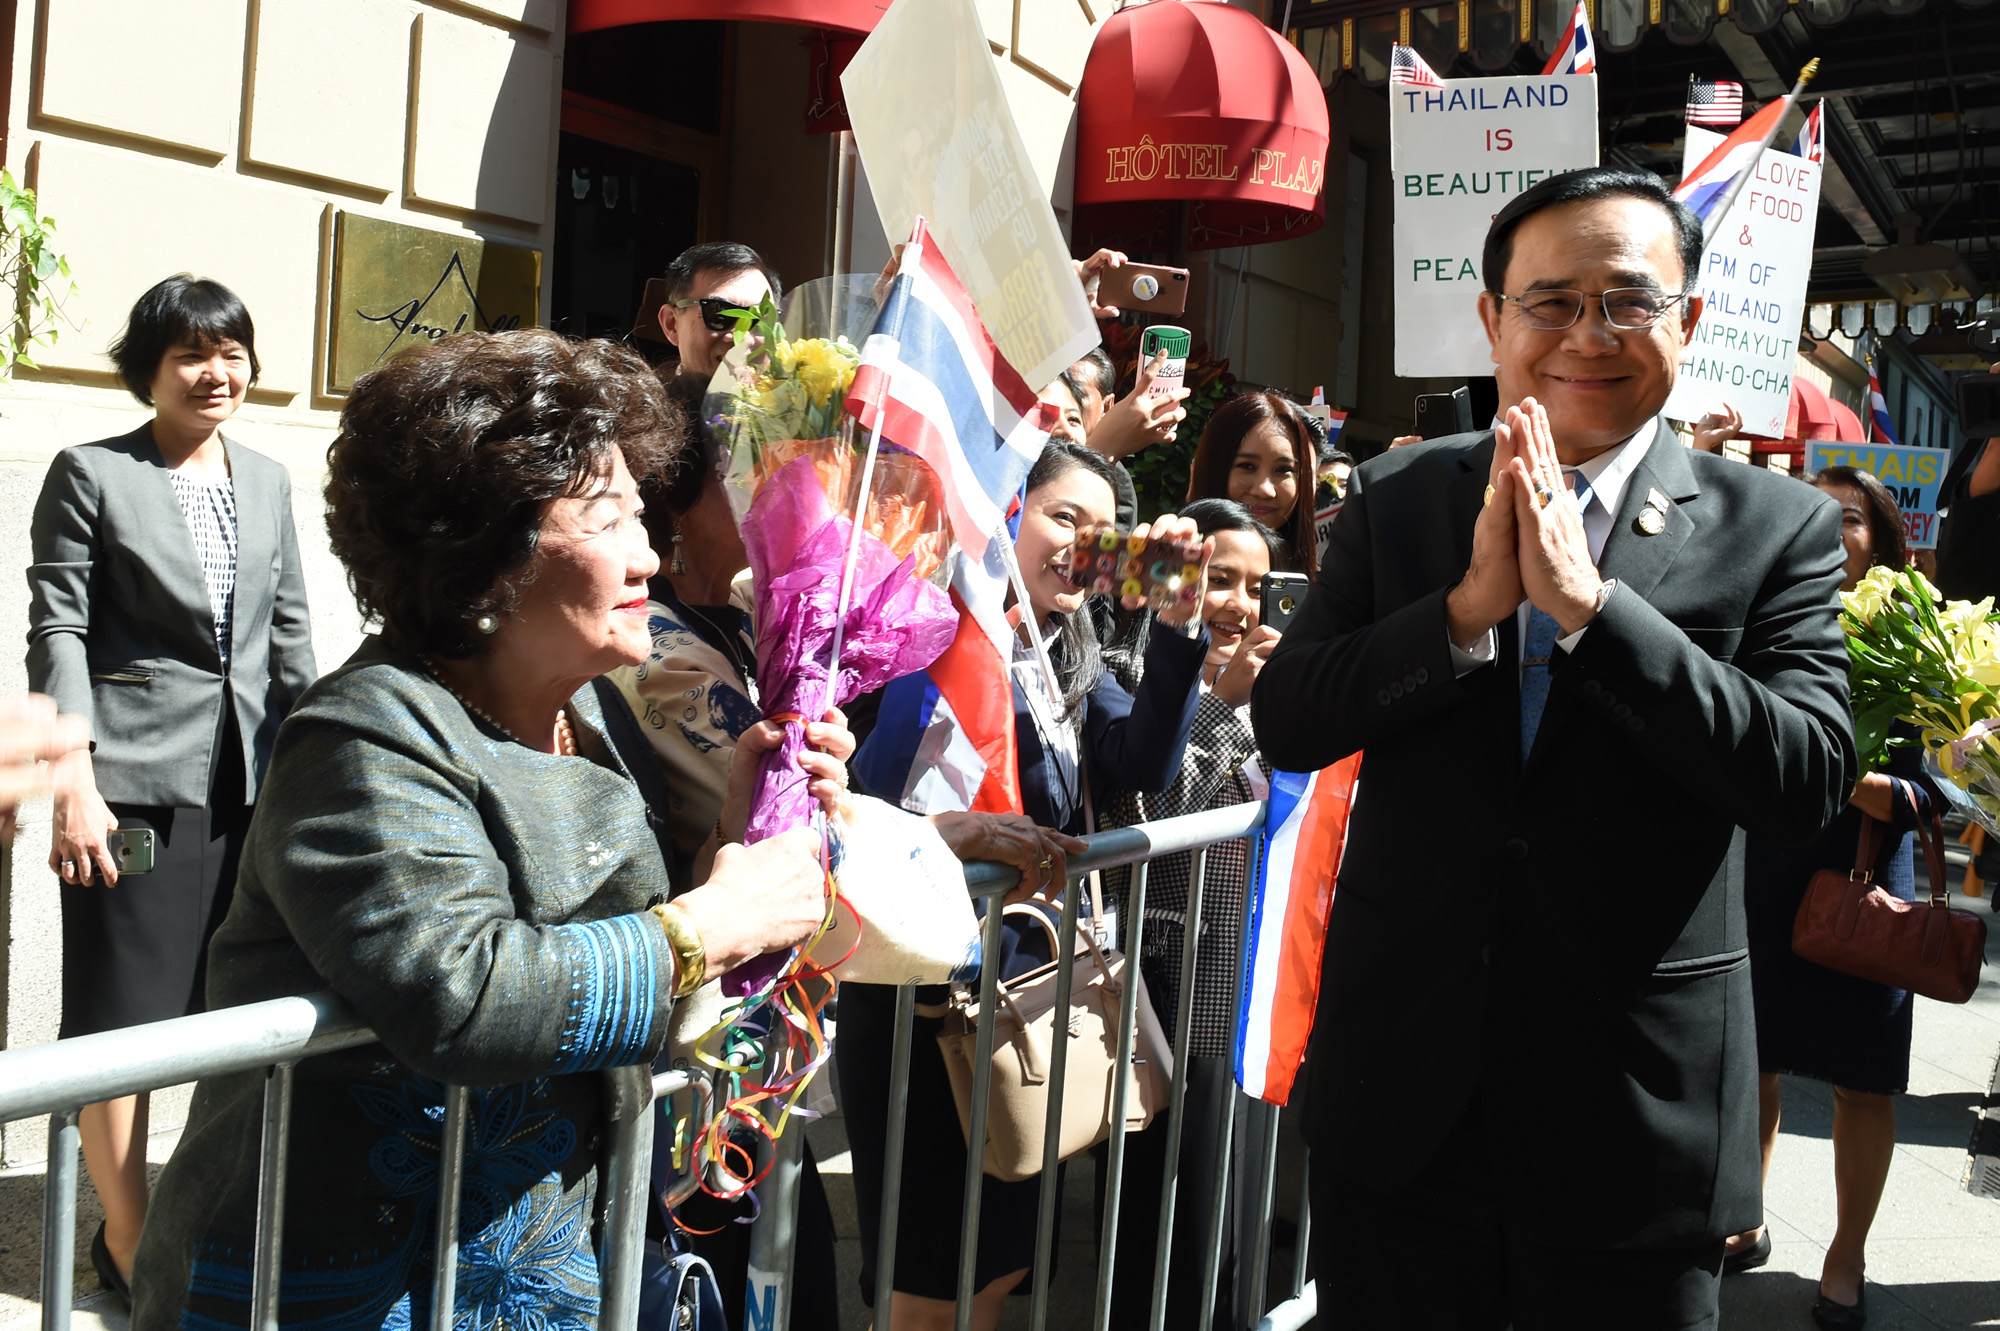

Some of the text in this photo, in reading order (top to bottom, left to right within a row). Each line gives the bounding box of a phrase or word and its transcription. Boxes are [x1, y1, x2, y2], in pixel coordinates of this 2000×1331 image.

[1403, 84, 1569, 113] THAILAND
[1486, 128, 1514, 152] IS
[1106, 134, 1238, 183] HÔTEL
[1755, 158, 1810, 192] LOVE
[1404, 168, 1576, 197] BEAUTIF
[1750, 191, 1803, 223] FOOD
[1739, 225, 1753, 247] &
[1708, 252, 1776, 286] PM OF
[1702, 288, 1781, 324] AILAND
[1691, 321, 1793, 360] N.PRAYUT
[1817, 448, 1938, 485] THAIS
